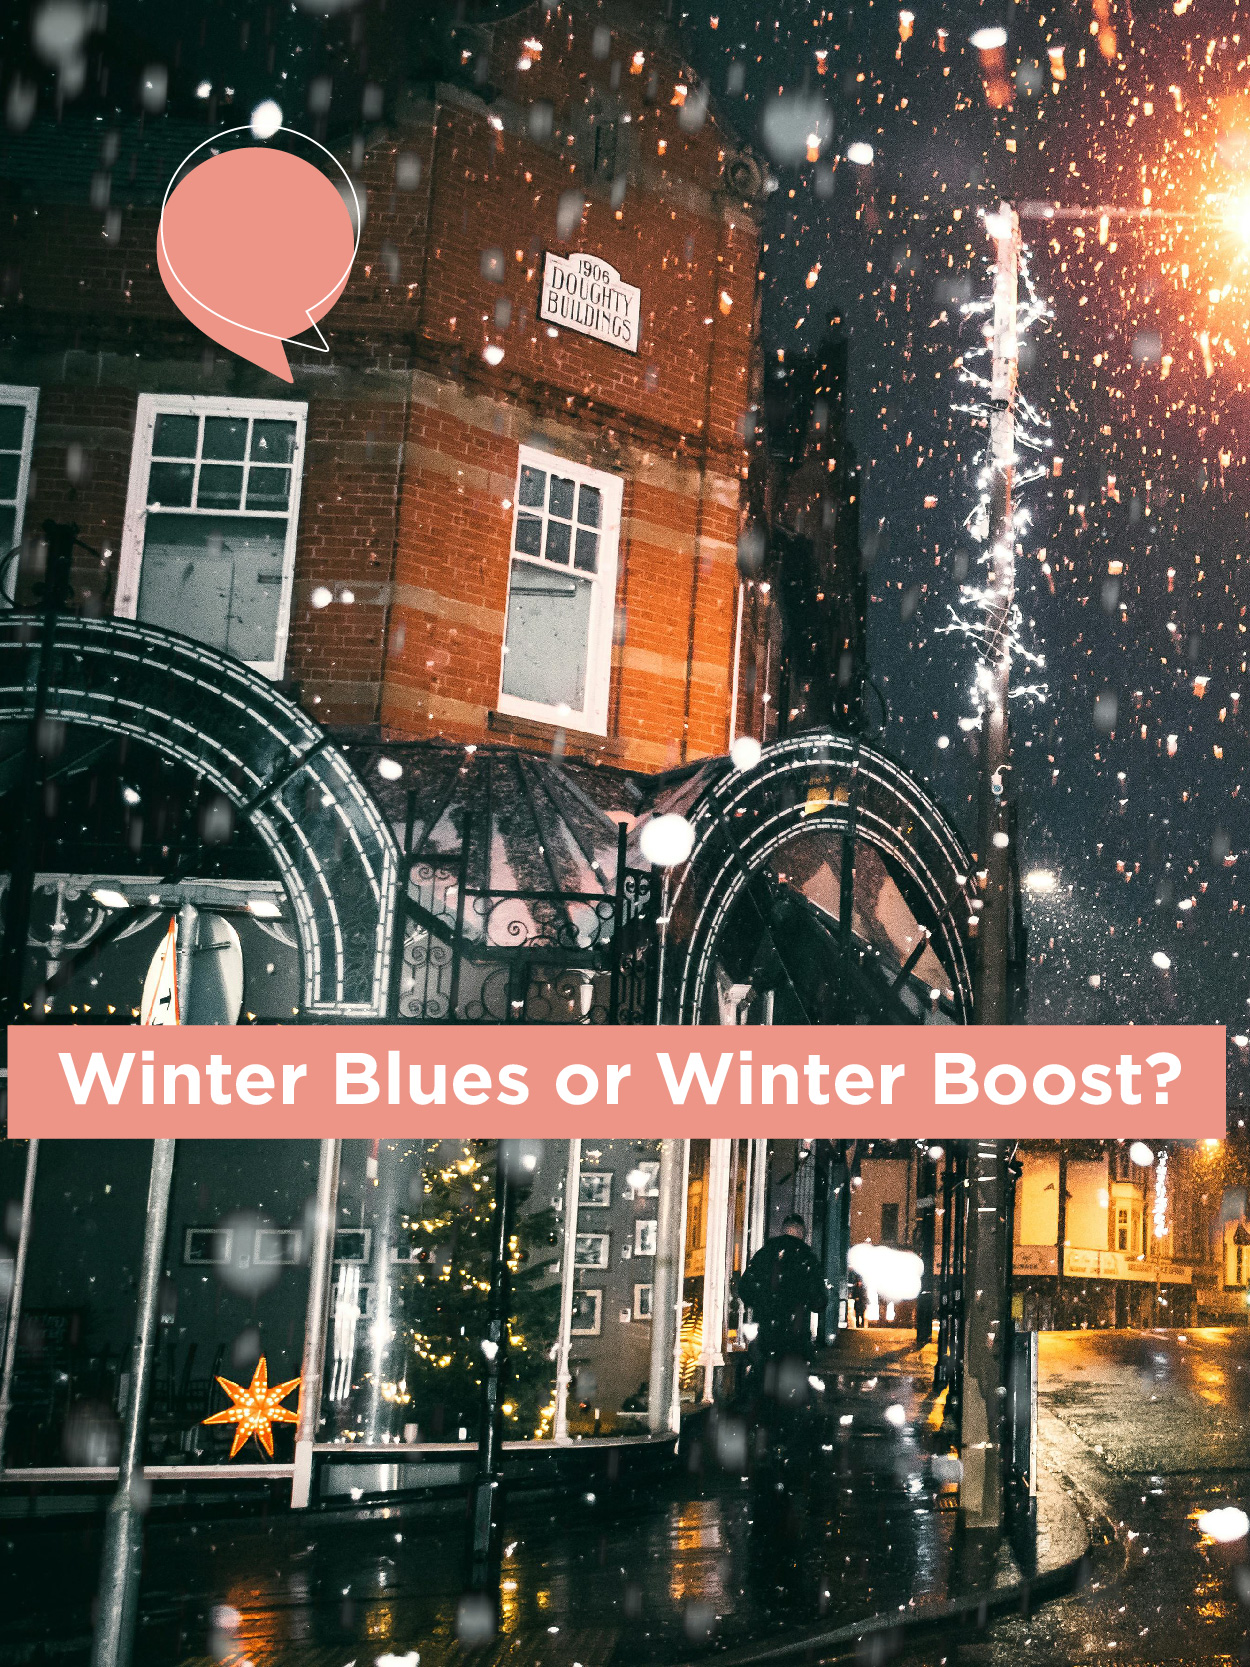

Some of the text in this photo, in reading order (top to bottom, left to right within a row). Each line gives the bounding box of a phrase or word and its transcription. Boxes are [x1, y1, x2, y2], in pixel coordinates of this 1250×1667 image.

[552, 267, 633, 316] DOUGHTY
[579, 260, 610, 285] 1906
[548, 291, 631, 342] BUILDINGS
